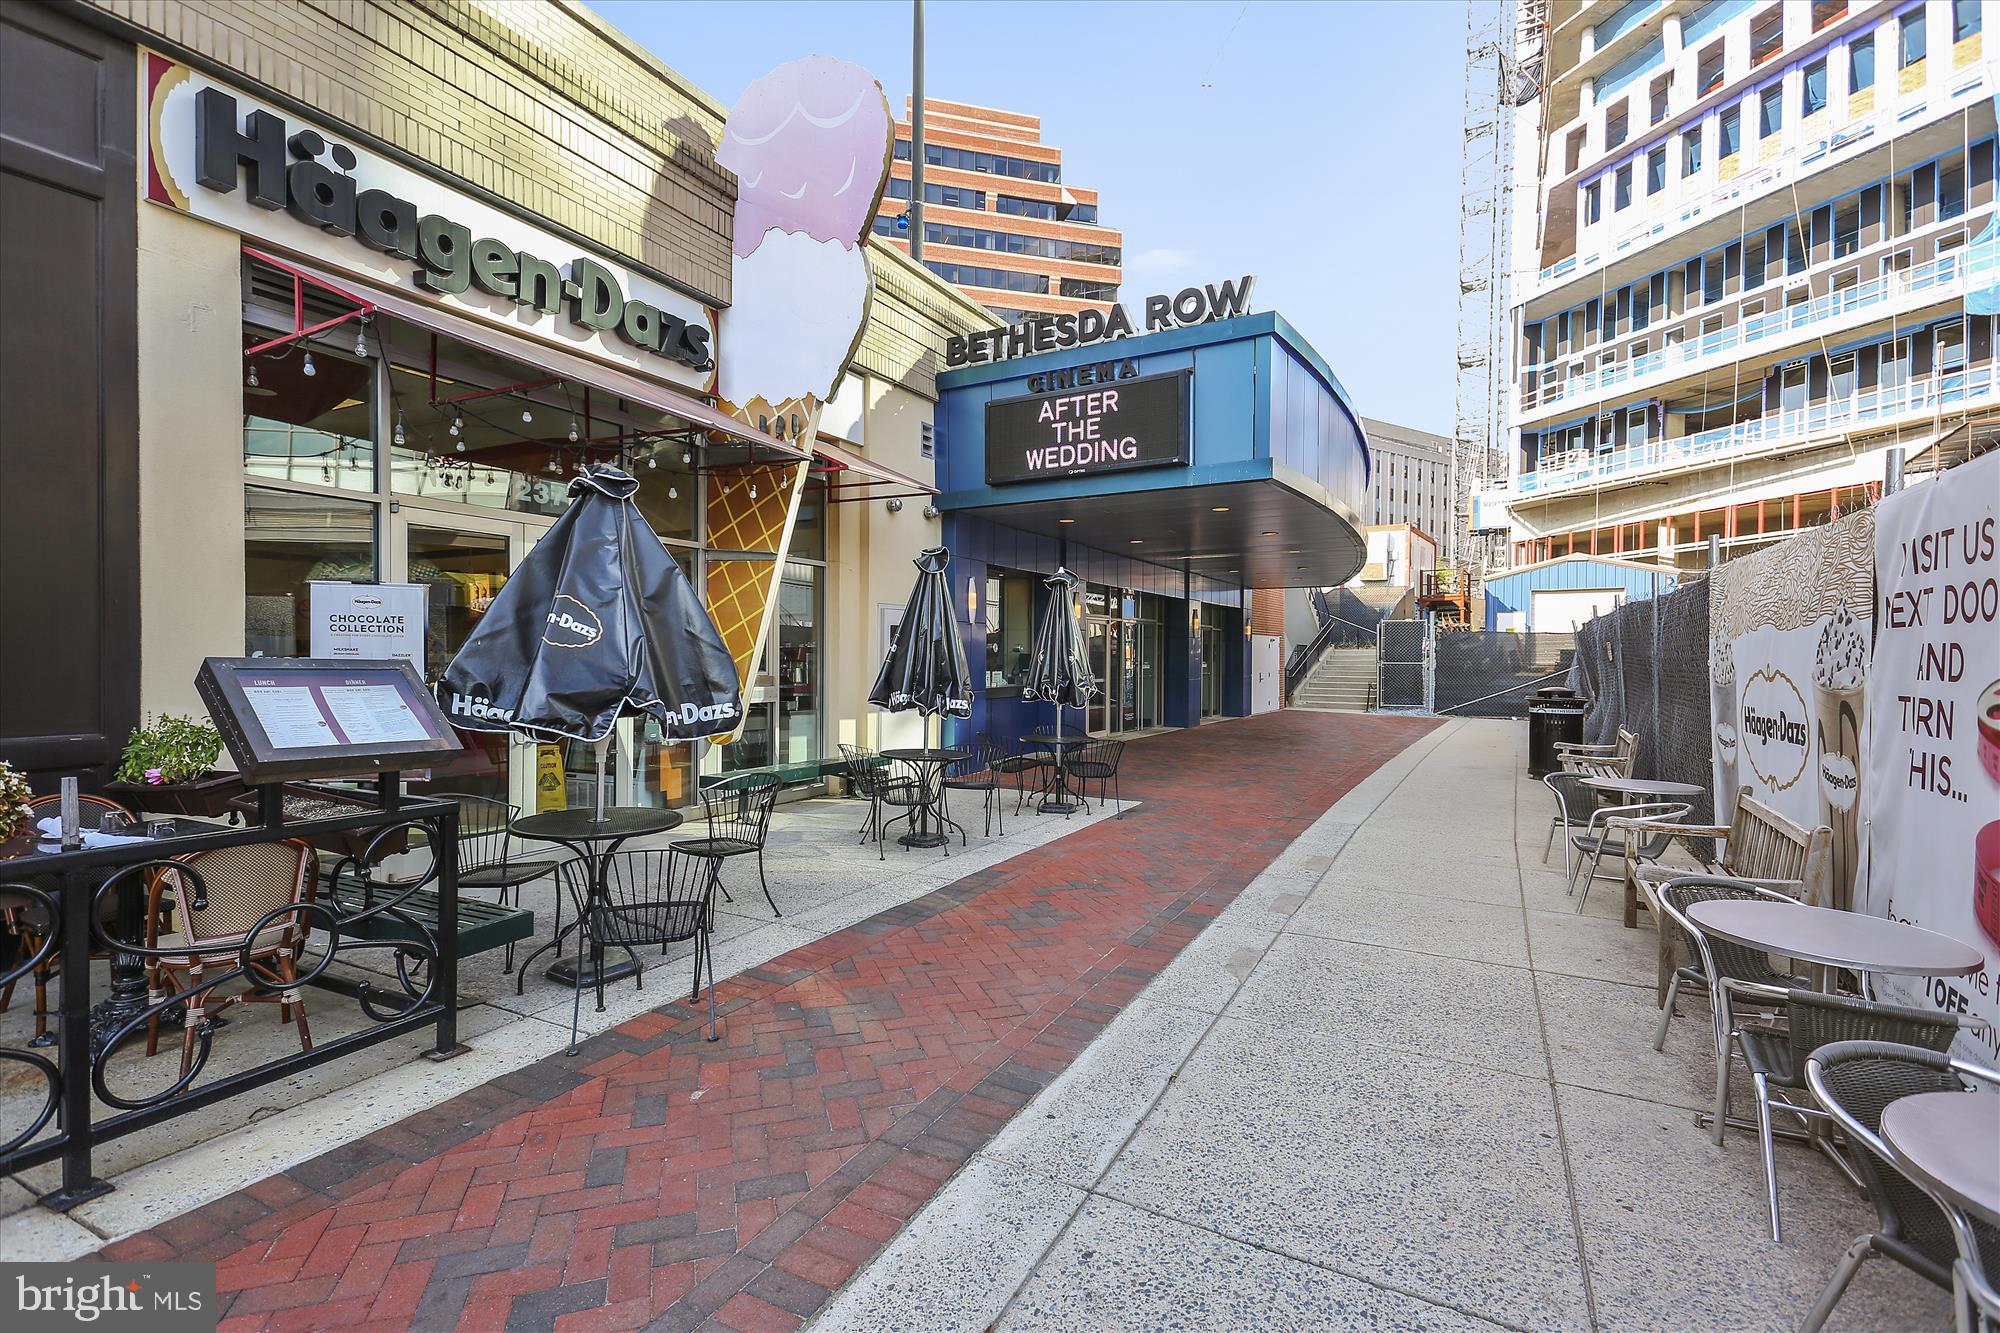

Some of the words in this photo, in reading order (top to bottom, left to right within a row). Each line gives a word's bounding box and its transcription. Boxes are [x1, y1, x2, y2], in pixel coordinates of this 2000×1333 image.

[195, 86, 711, 372] Häagen-Dazs
[946, 304, 1138, 368] BETHESDA
[1145, 275, 1255, 333] ROW
[1027, 358, 1138, 393] CINEMA
[1038, 390, 1120, 424] AFTER
[1051, 419, 1101, 445] THE
[1025, 437, 1138, 471] WEDDING
[1963, 517, 1995, 565] US
[329, 614, 405, 624] CHOCOLATE
[329, 624, 405, 634] COLLECTION
[1744, 706, 1807, 746] Häagen-Dazs
[1908, 747, 1969, 803] HIS...
